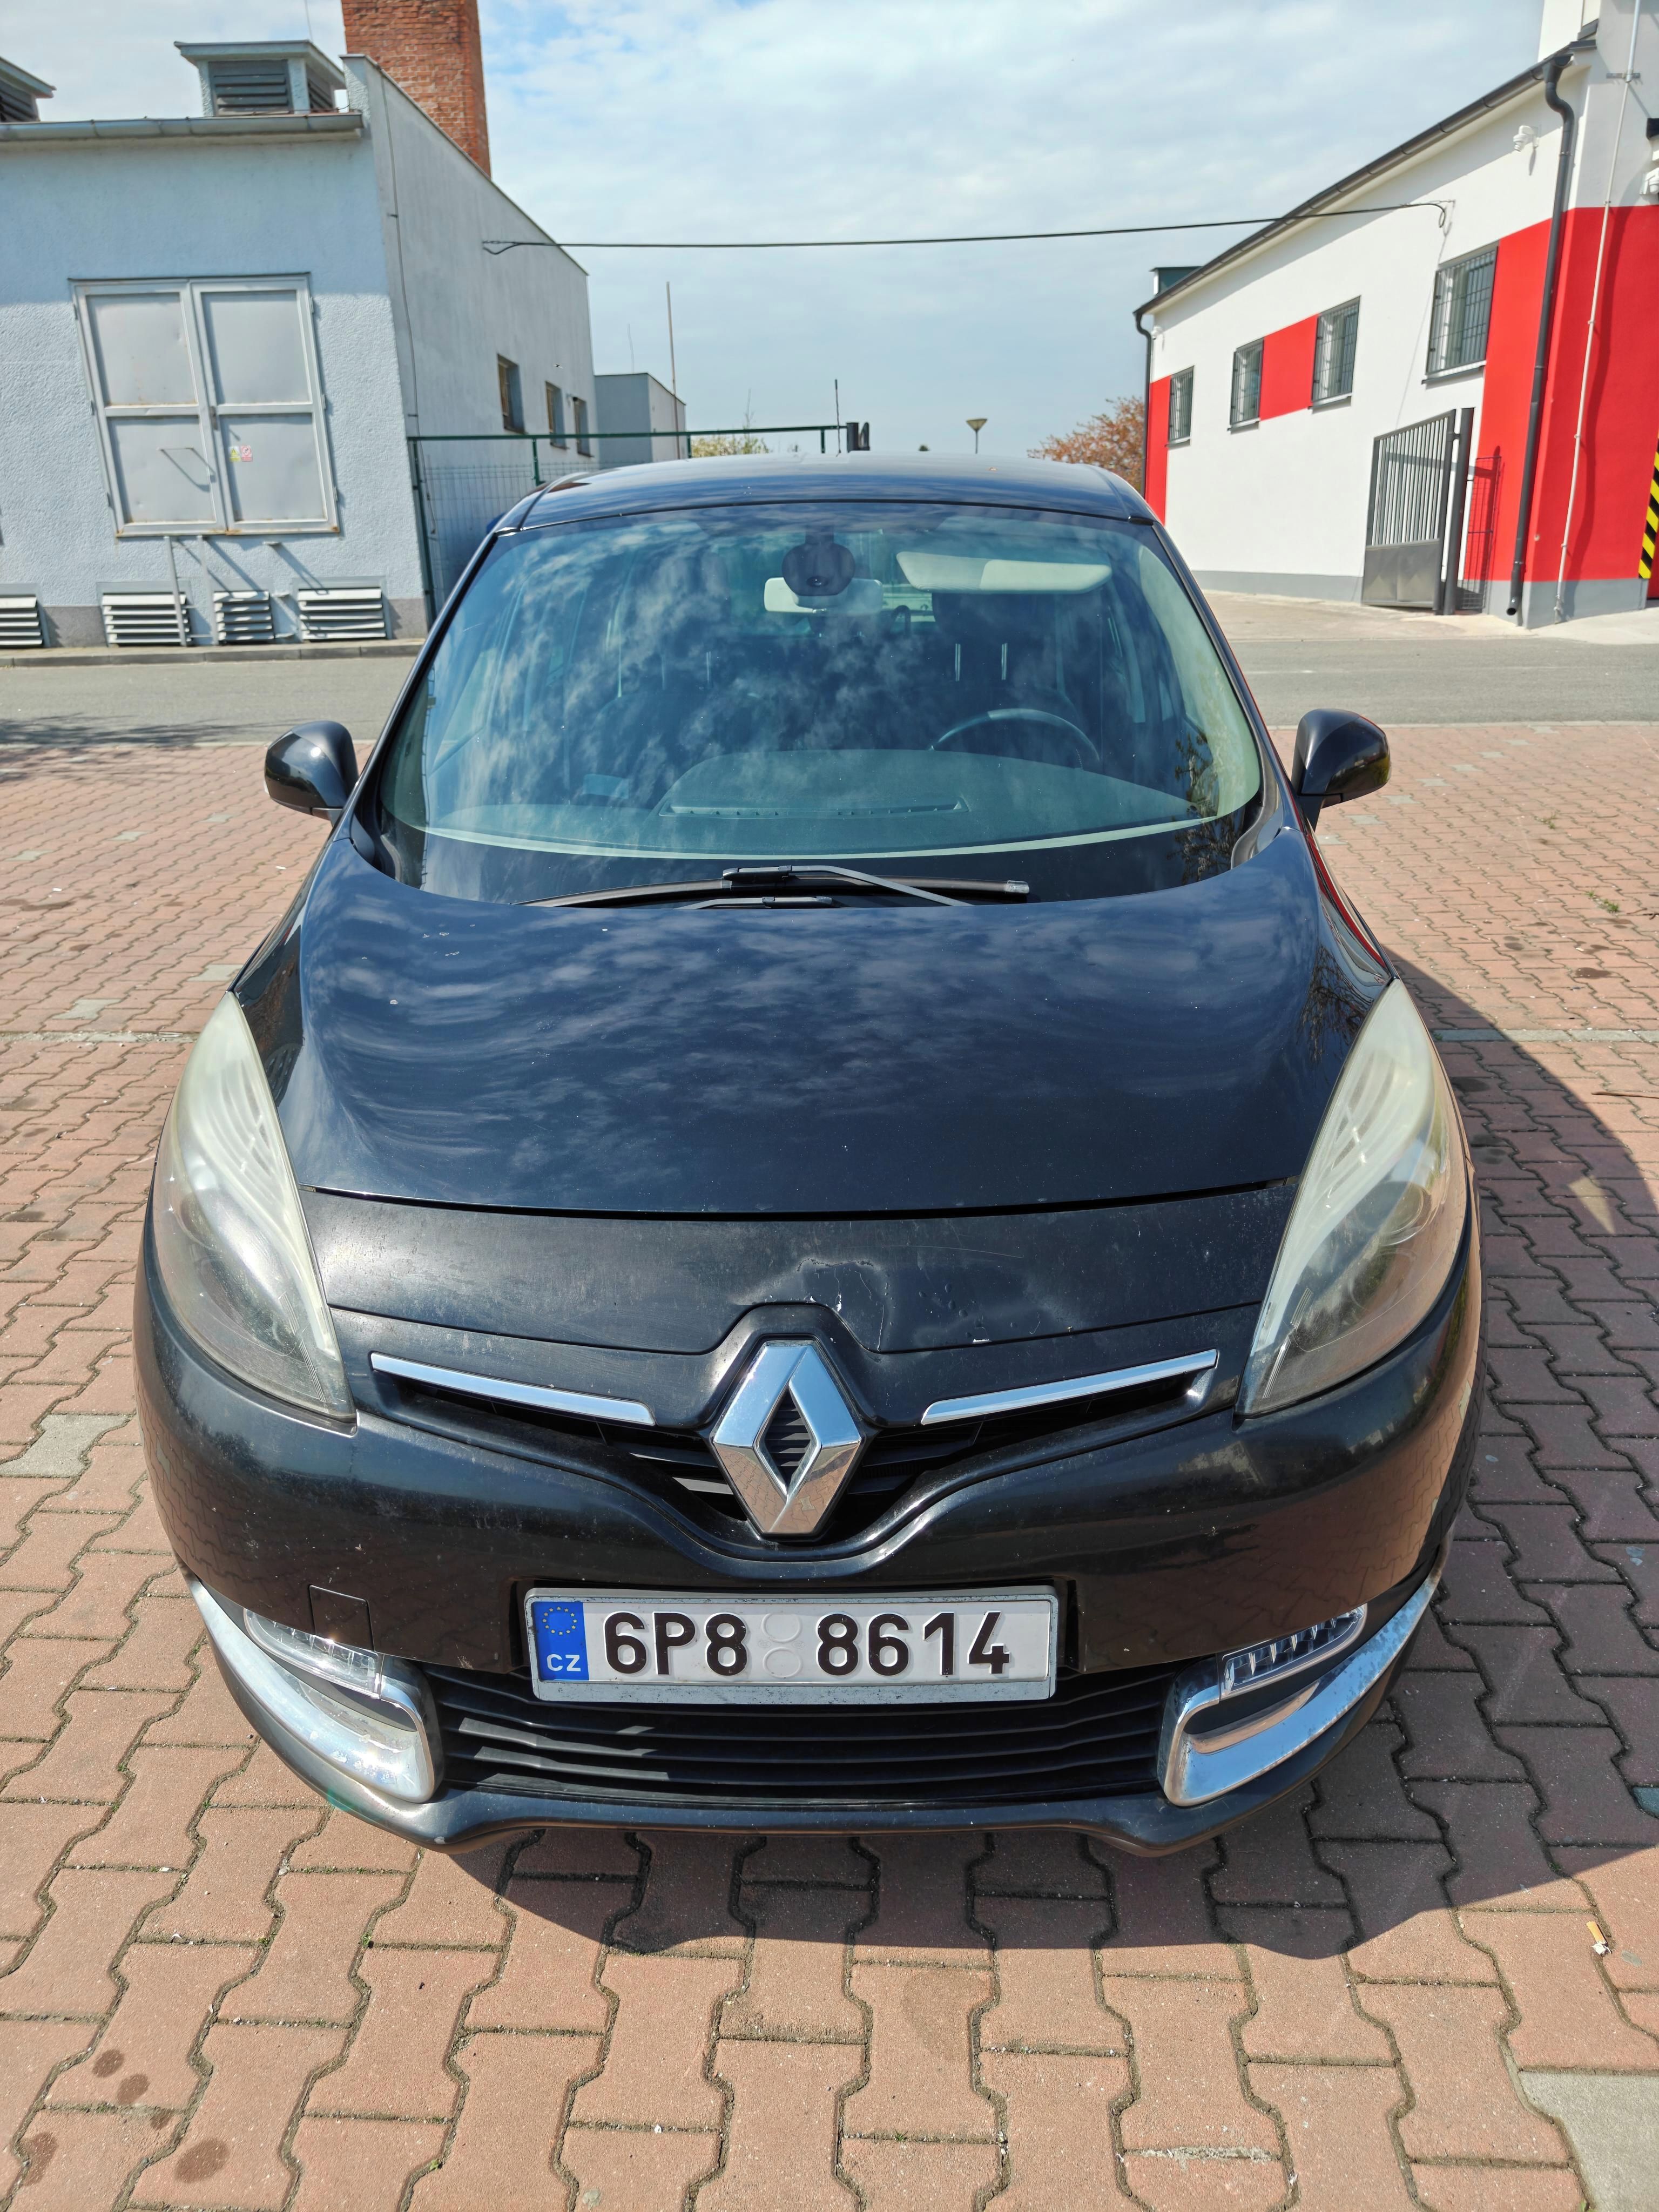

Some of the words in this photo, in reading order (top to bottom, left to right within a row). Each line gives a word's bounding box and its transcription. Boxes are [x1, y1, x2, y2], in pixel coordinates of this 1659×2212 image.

[547, 1654, 582, 1672] CZ
[604, 1611, 747, 1676] 6P8
[817, 1611, 1010, 1676] 8614
